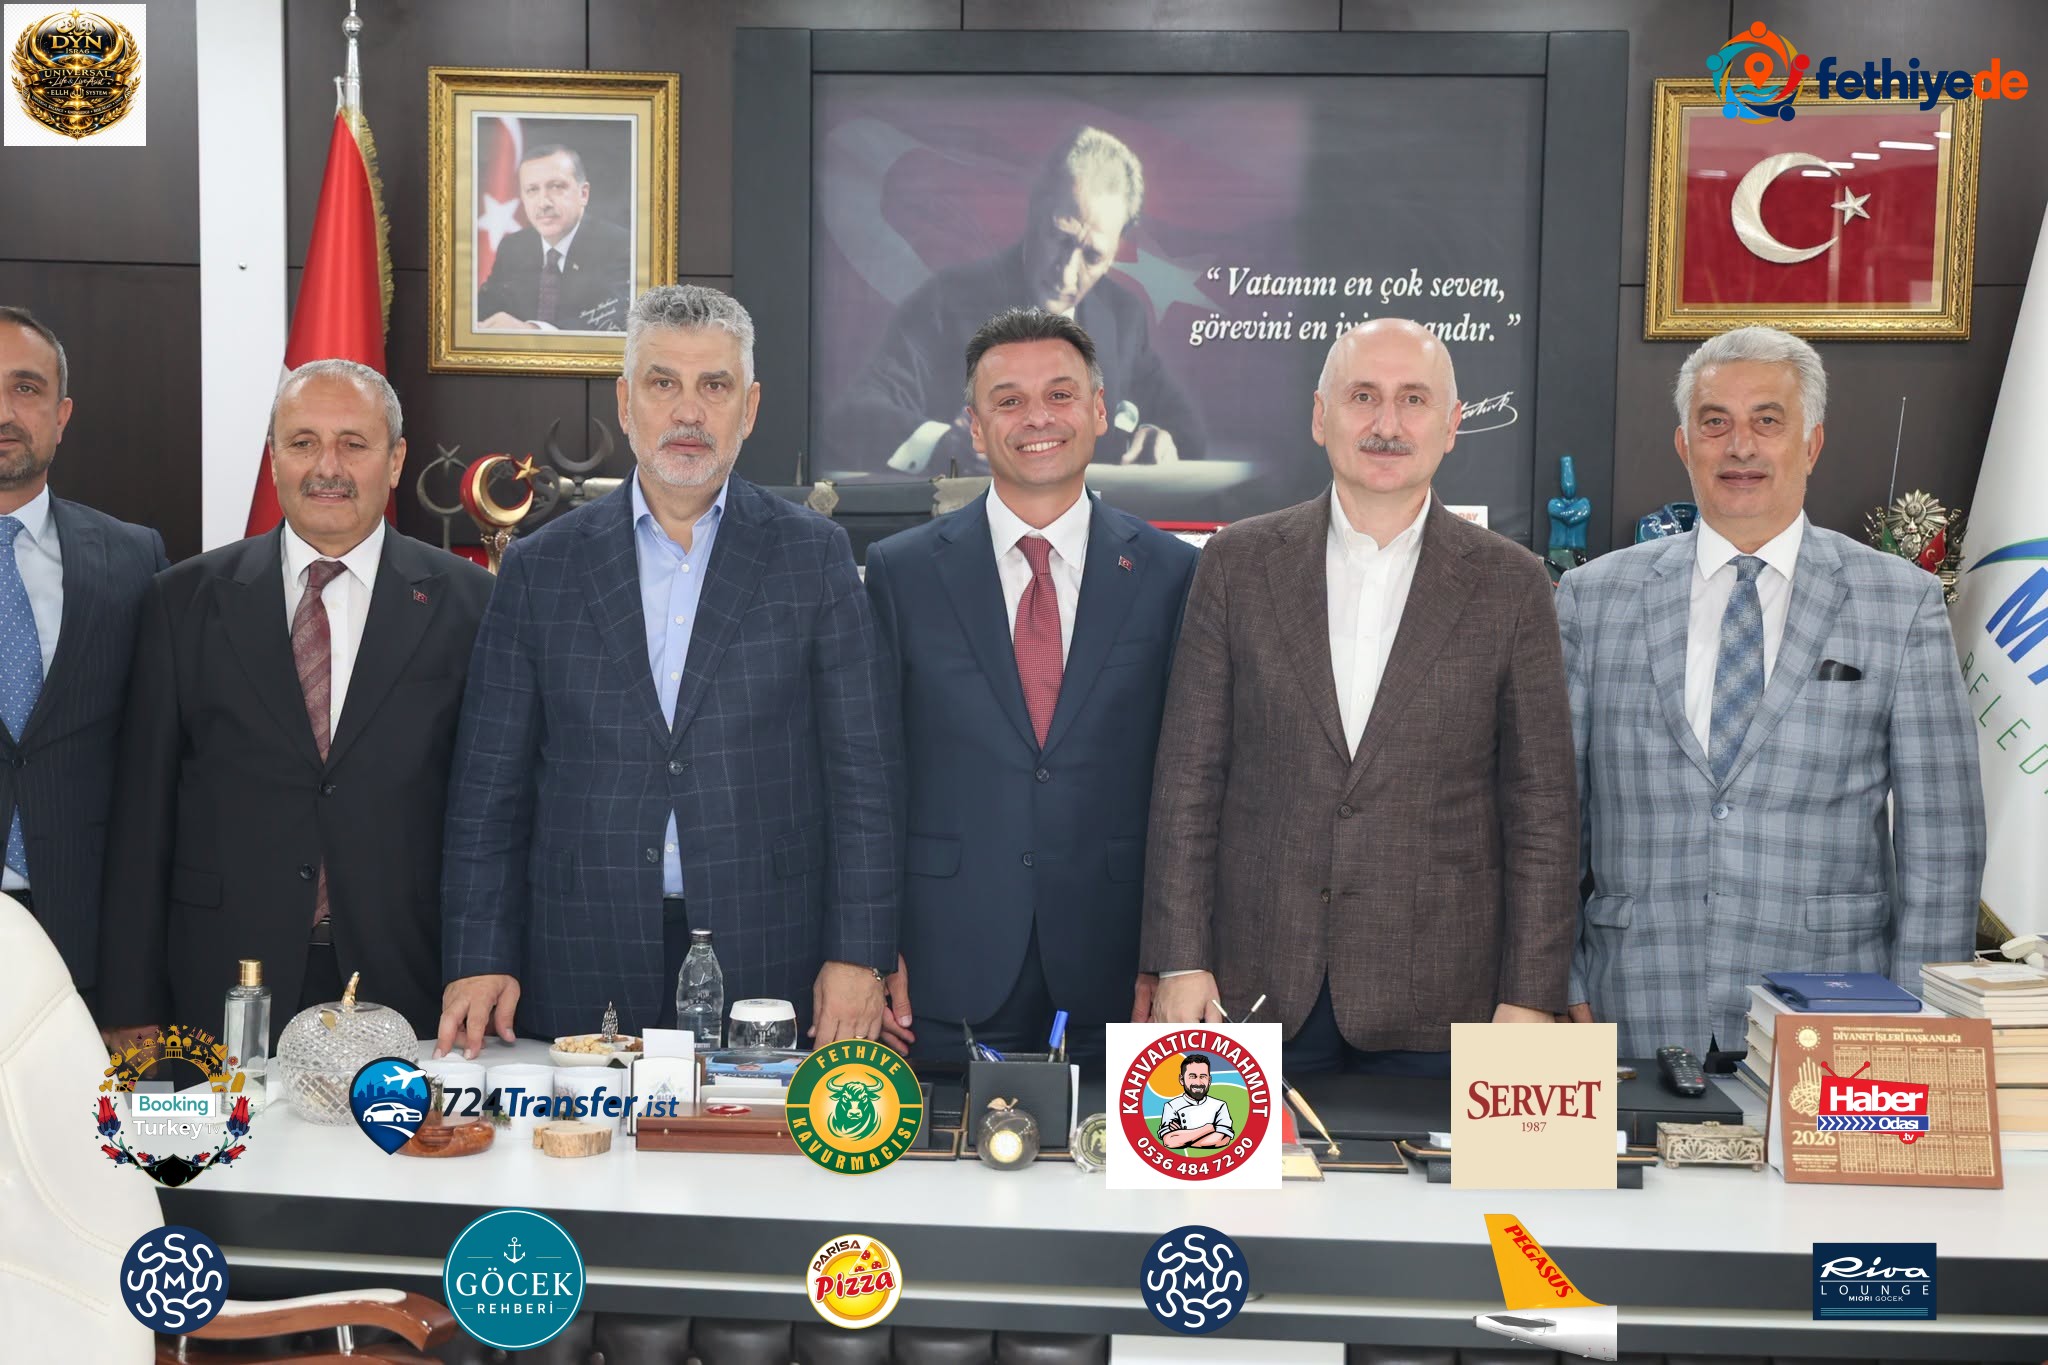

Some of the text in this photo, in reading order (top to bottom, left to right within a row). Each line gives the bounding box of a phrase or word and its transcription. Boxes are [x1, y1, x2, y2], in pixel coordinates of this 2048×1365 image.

[1228, 267, 1337, 296] Vatanını
[1344, 277, 1373, 296] en
[1380, 268, 1423, 304] çok
[1430, 277, 1505, 303] seven,
[1189, 311, 1293, 346] görevini
[1299, 320, 1328, 340] en
[1792, 1130, 1836, 1146] 2026
